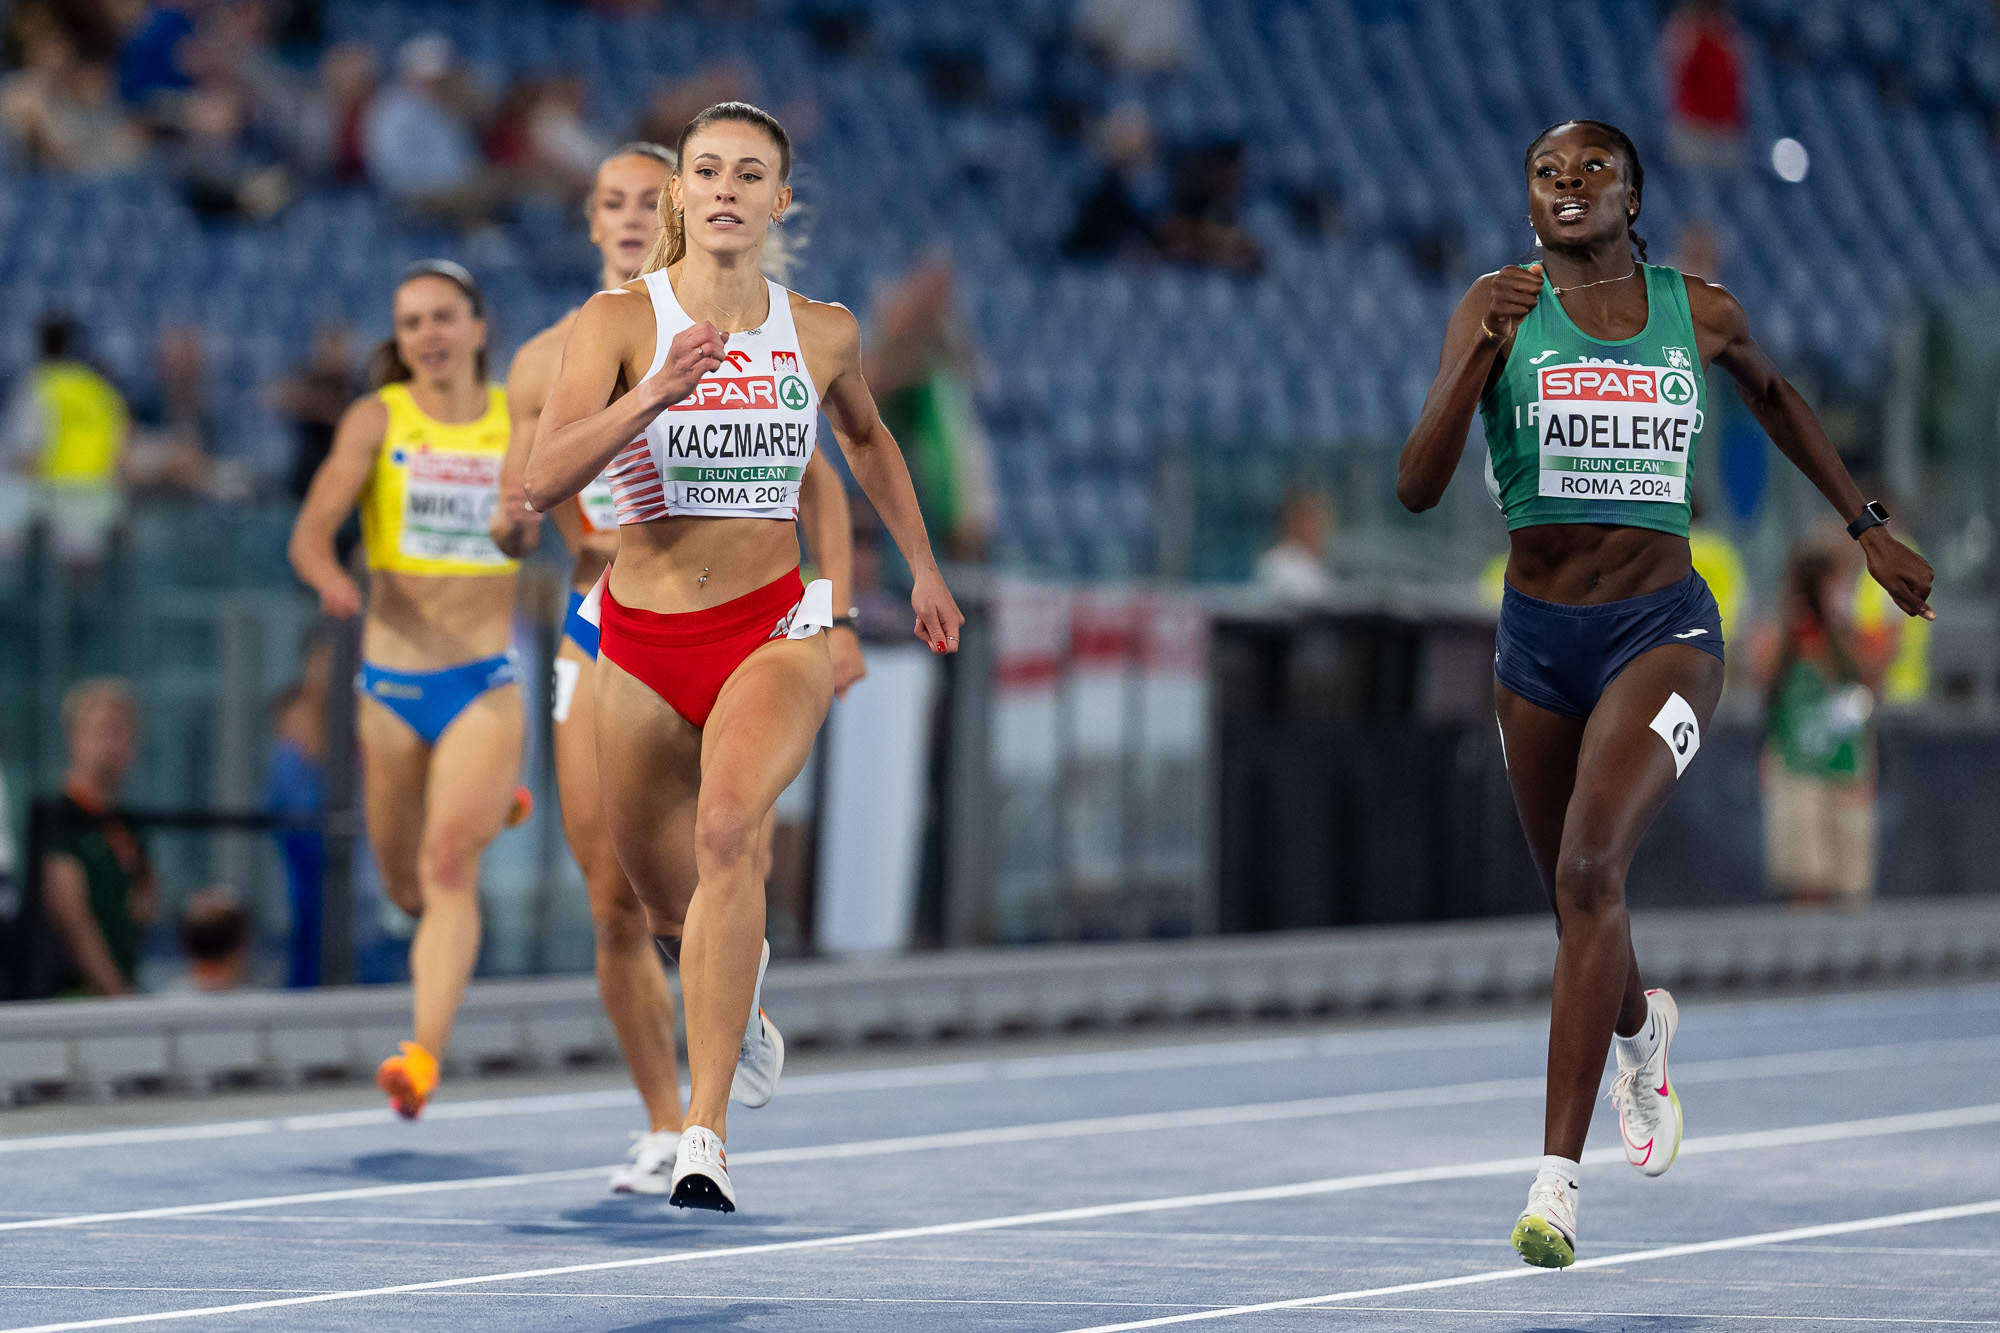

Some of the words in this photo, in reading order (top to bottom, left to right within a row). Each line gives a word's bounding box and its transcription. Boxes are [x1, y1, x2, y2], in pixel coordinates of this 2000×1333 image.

[1545, 371, 1655, 399] SPAR
[668, 422, 810, 459] KACZMAREK
[1543, 414, 1689, 453] ADELEKE
[705, 468, 738, 480] RUN
[1580, 459, 1611, 472] RUN
[686, 486, 750, 504] ROMA
[1561, 476, 1625, 495] ROMA
[1629, 479, 1672, 497] 2024
[1672, 721, 1695, 756] 6
